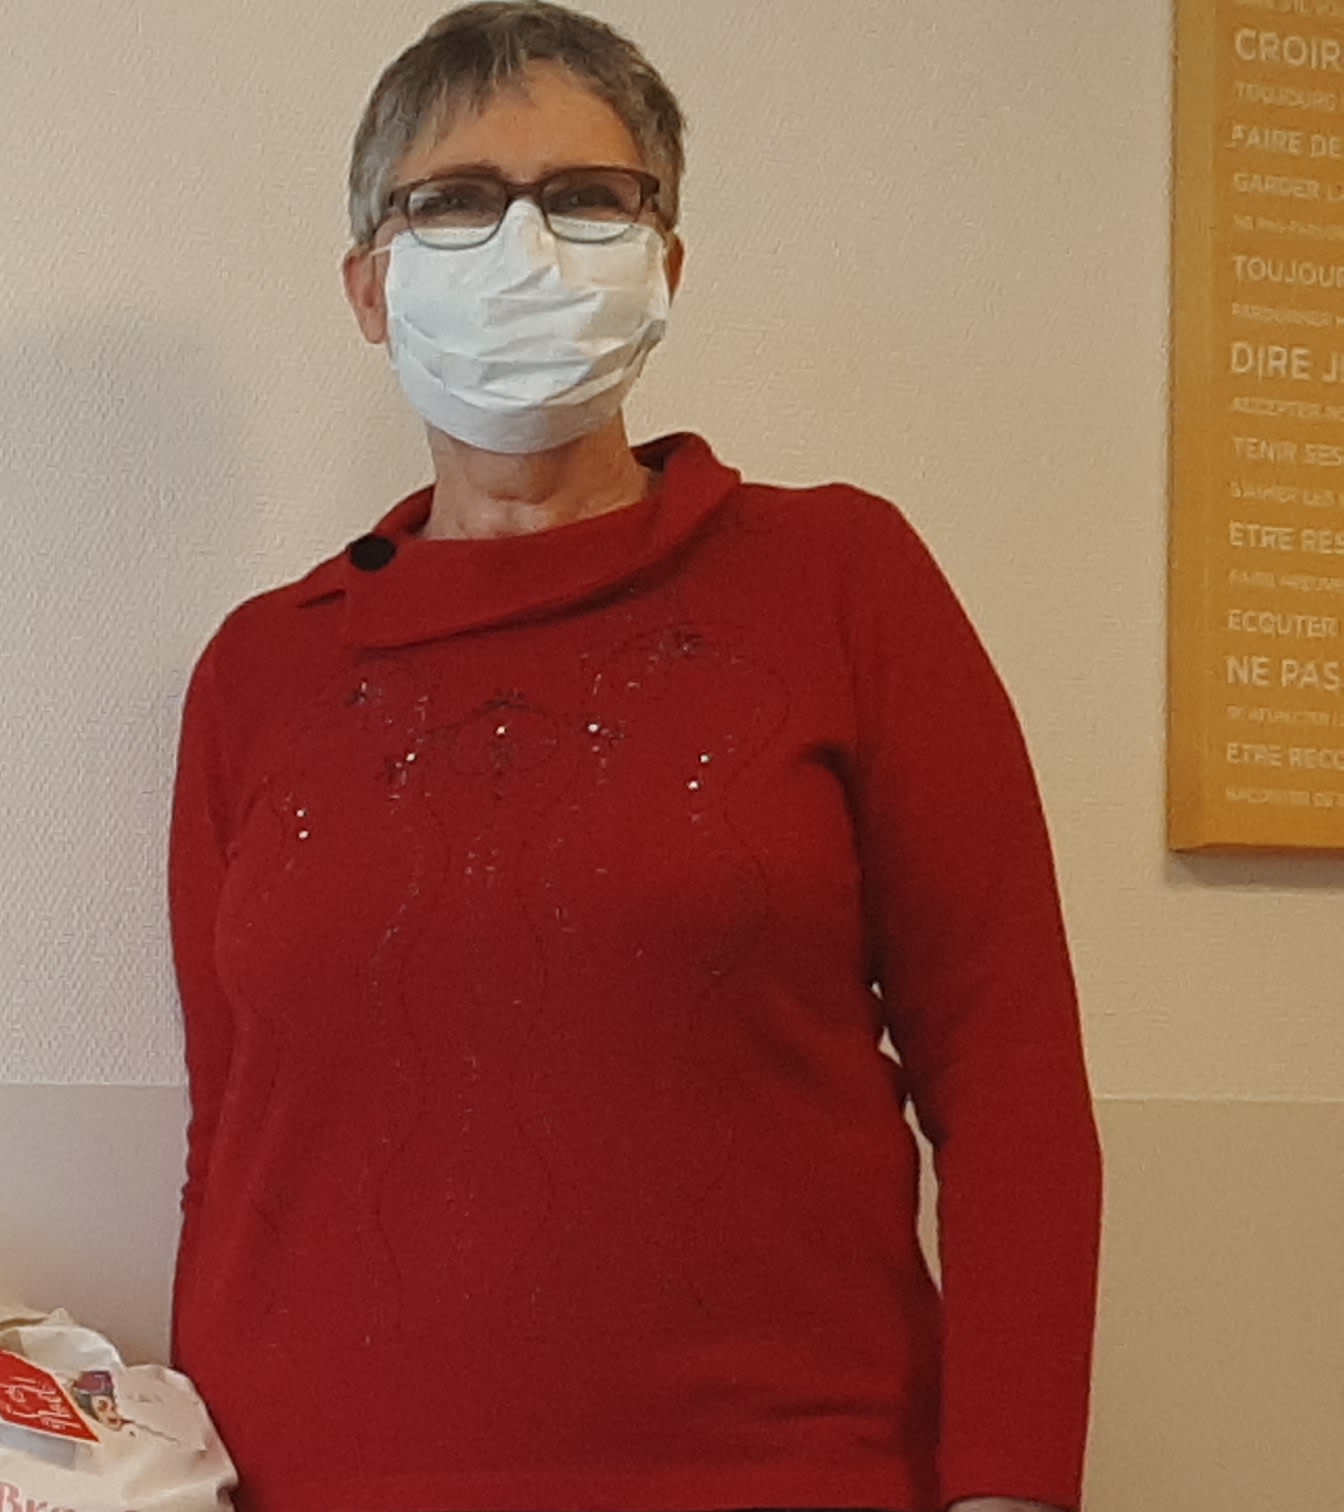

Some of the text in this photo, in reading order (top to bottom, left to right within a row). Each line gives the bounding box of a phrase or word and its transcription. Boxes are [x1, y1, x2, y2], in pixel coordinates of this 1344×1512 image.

[1230, 341, 1312, 381] DIRE
[1224, 655, 1341, 693] NE PAS
